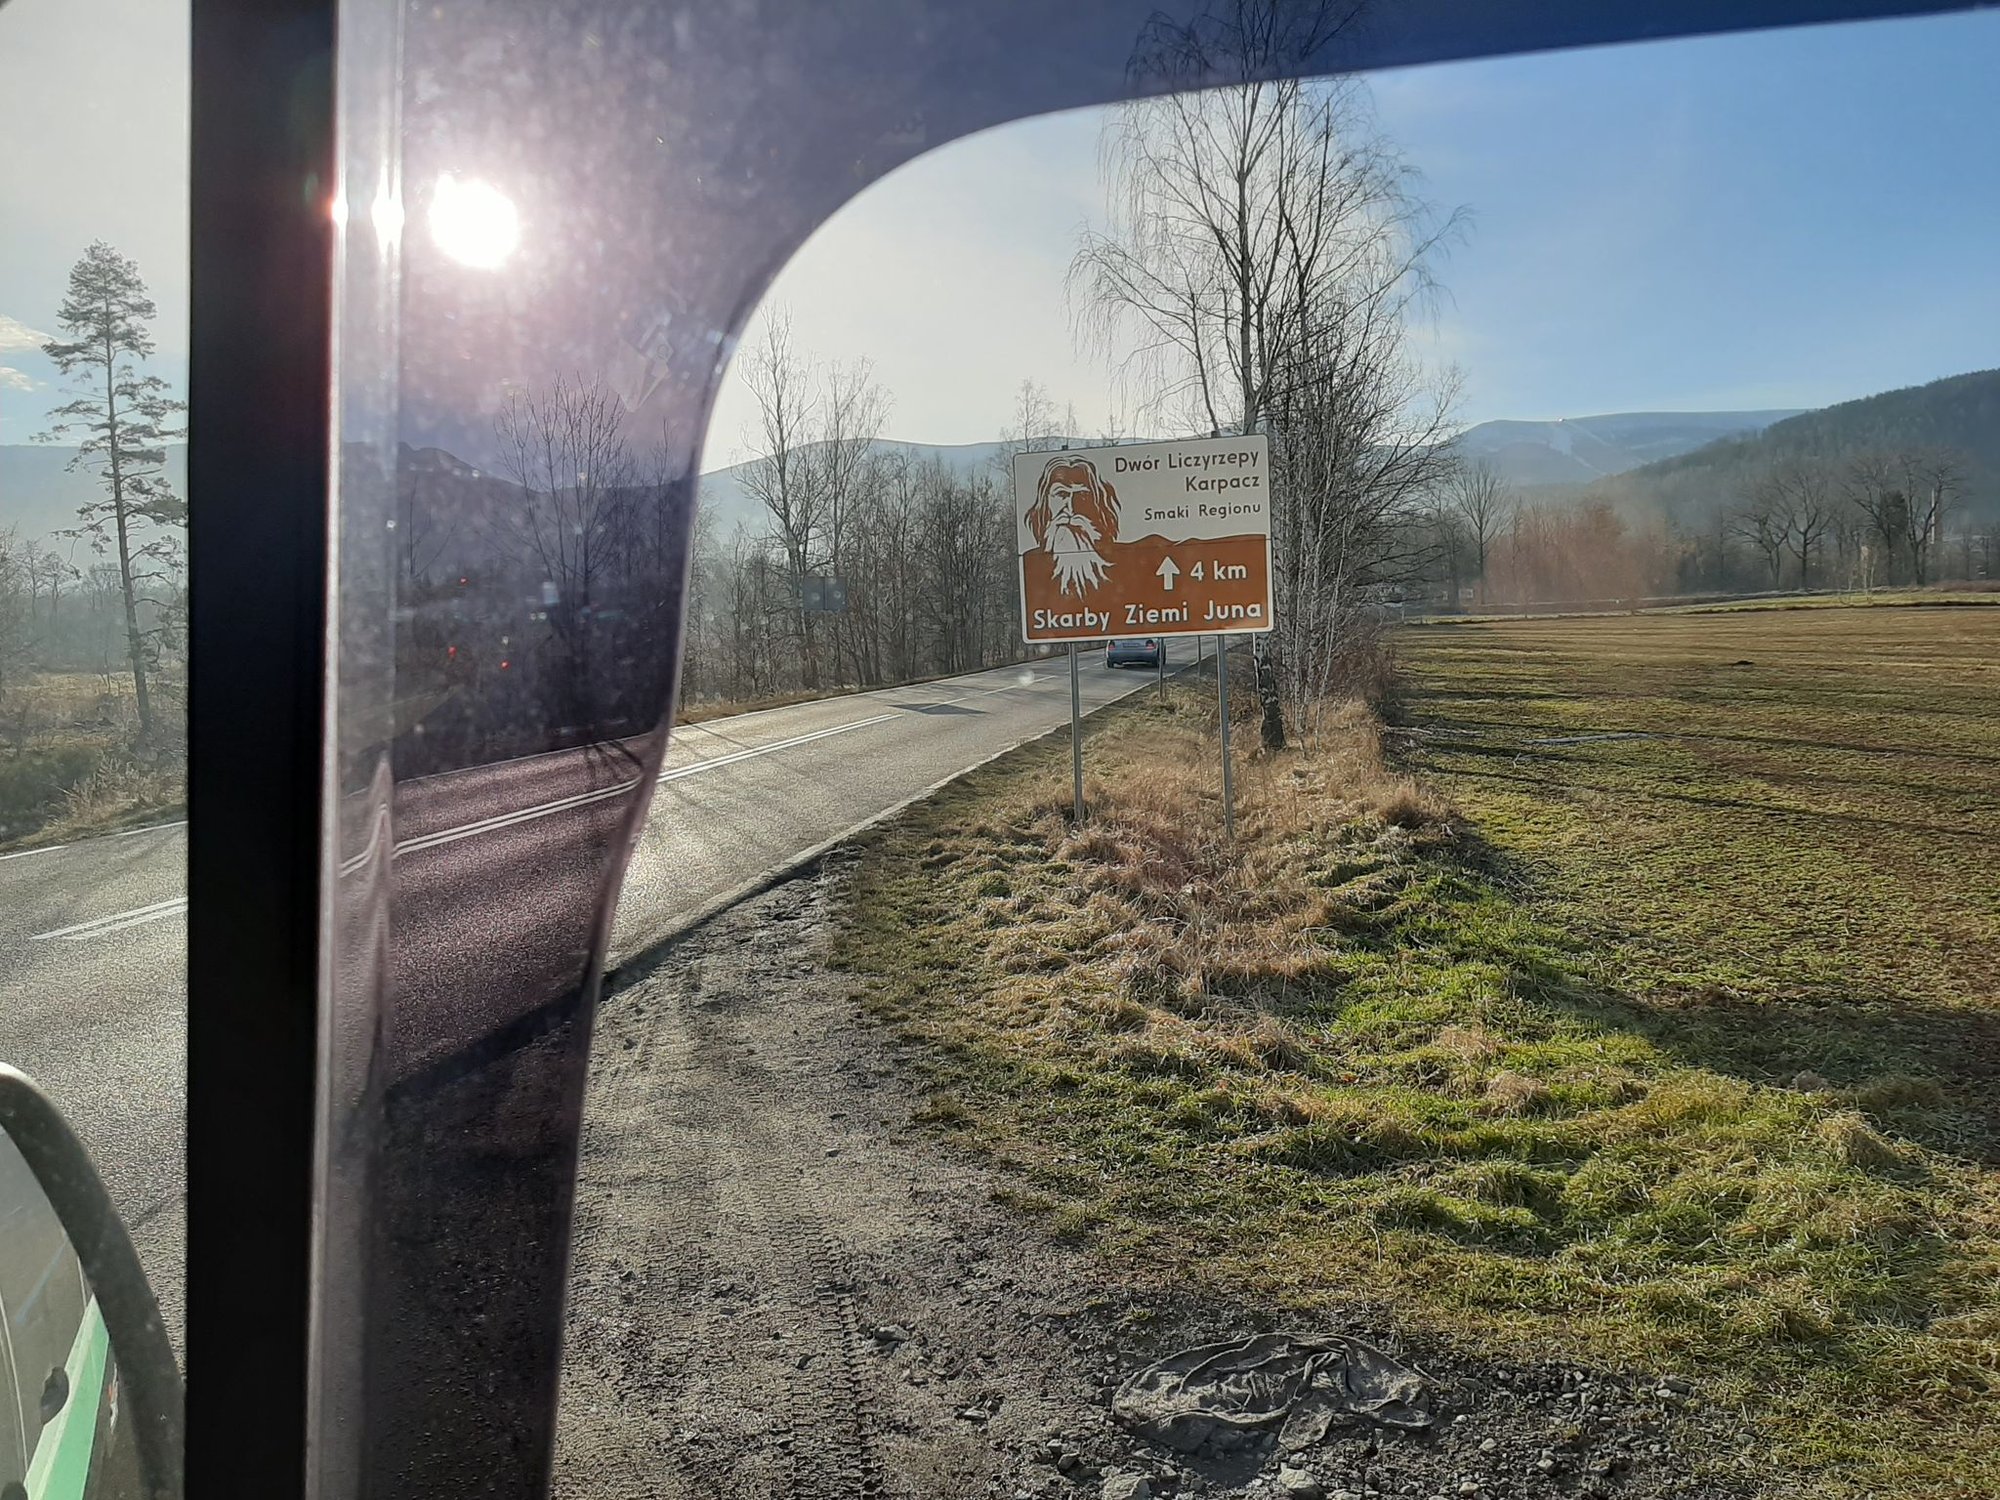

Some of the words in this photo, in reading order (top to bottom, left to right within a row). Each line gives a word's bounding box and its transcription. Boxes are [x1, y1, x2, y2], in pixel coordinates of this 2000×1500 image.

[1116, 455, 1160, 472] Dwór
[1168, 451, 1258, 470] Liczyrzepy
[1186, 476, 1260, 494] Karpacz
[1145, 502, 1189, 521] Smaki
[1199, 503, 1261, 519] Regionu
[1190, 562, 1203, 581] 4
[1214, 560, 1247, 580] km
[1033, 609, 1110, 631] Skarby
[1125, 602, 1188, 624] Ziemi
[1204, 601, 1261, 620] Juna
